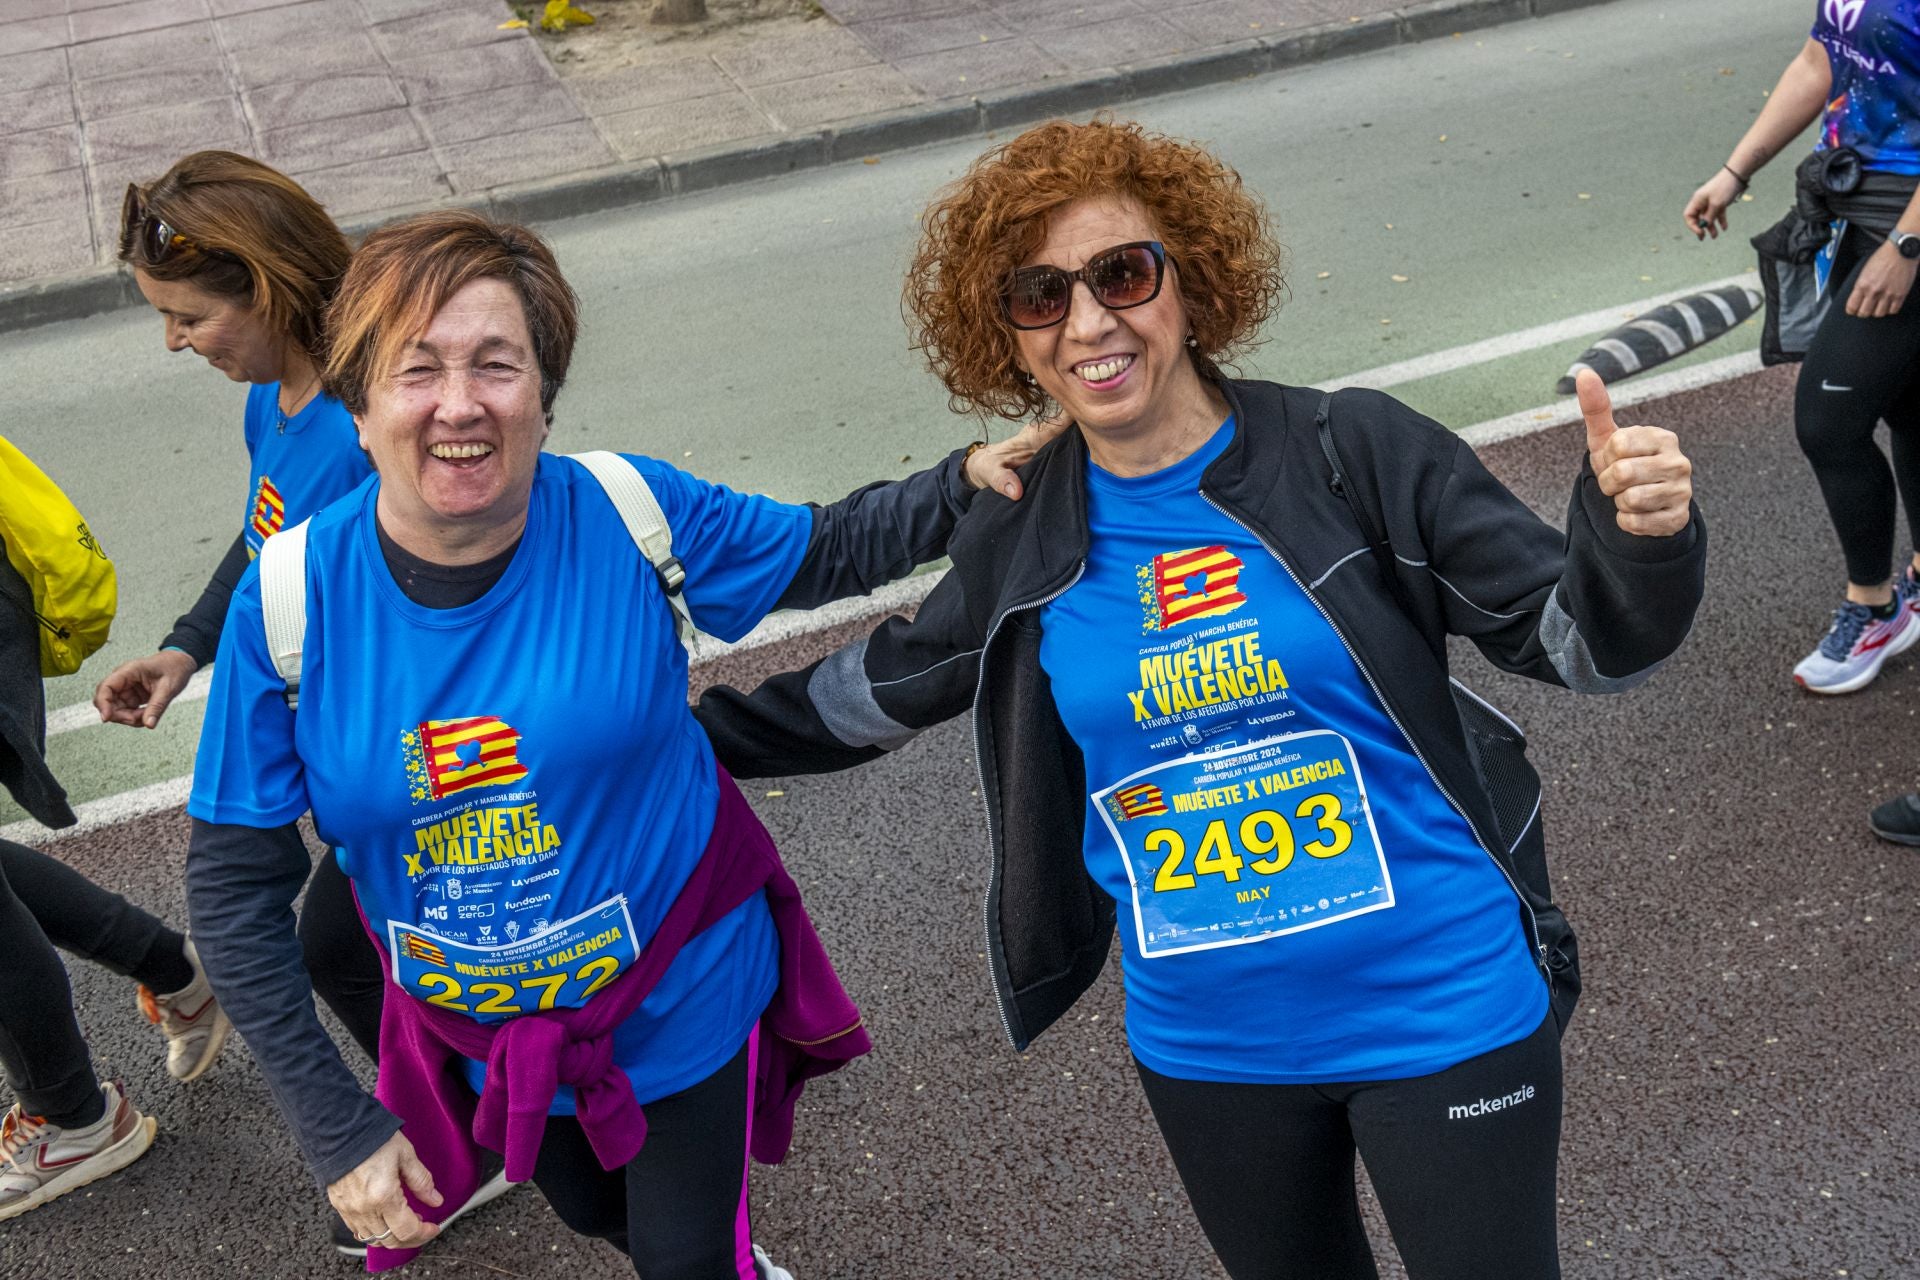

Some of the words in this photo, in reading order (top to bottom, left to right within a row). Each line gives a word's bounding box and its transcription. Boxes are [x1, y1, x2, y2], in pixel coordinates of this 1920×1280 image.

[1138, 644, 1169, 655] CARRERA
[1169, 635, 1194, 650] POPULAR
[1194, 633, 1199, 641] Y
[1199, 626, 1226, 639] MARCHA
[1227, 618, 1259, 632] BENÉFICA
[1139, 632, 1263, 690] MUÉVETE
[1127, 689, 1153, 723] X
[1152, 658, 1289, 716] VALENCIA
[1141, 720, 1148, 731] A
[1149, 716, 1171, 729] FAVOR
[1171, 713, 1183, 723] DE
[1183, 709, 1197, 721] LOS
[1197, 699, 1238, 718] AFECTADOS
[1239, 697, 1255, 709] POR
[1256, 694, 1266, 705] LA
[1267, 690, 1288, 703] DANA
[1258, 710, 1296, 724] VERDAD
[1194, 773, 1217, 785] CARRERA
[1217, 769, 1242, 781] POPULAR
[1248, 761, 1274, 773] MARCHA
[1274, 753, 1302, 766] BENÉFICA
[1261, 746, 1281, 759] 2024
[1172, 783, 1244, 815] MUÉVETE
[1245, 782, 1260, 800] X
[1260, 758, 1346, 796] VALENCIA
[412, 812, 443, 826] CARRERA
[444, 801, 473, 817] POPULAR
[474, 799, 479, 807] Y
[480, 795, 507, 804] MARCHA
[508, 790, 537, 801] BENÉFICA
[415, 803, 541, 851] MUÉVETE
[1144, 792, 1353, 893] 2493
[402, 853, 425, 877] X
[428, 824, 562, 865] VALENCIA
[442, 865, 450, 874] DE
[452, 865, 465, 875] LOS
[467, 860, 510, 874] AFECTADOS
[511, 855, 525, 867] POR
[528, 853, 537, 864] LA
[539, 848, 559, 862] DANA
[512, 876, 523, 887] LA
[524, 868, 560, 885] VERDAD
[458, 904, 477, 912] pre
[505, 893, 551, 910] fundown
[1235, 886, 1271, 904] MAY
[459, 911, 485, 919] zero
[440, 930, 468, 938] UCAM
[503, 939, 547, 956] NOVIEMBRE
[550, 929, 568, 943] 2024
[455, 961, 528, 978] MUÉVETE
[534, 959, 544, 971] X
[547, 927, 623, 967] VALENCIA
[505, 954, 531, 963] POPULAR
[537, 943, 560, 955] MARCHA
[418, 955, 621, 1013] 2272
[1448, 1084, 1535, 1120] mckenzie
